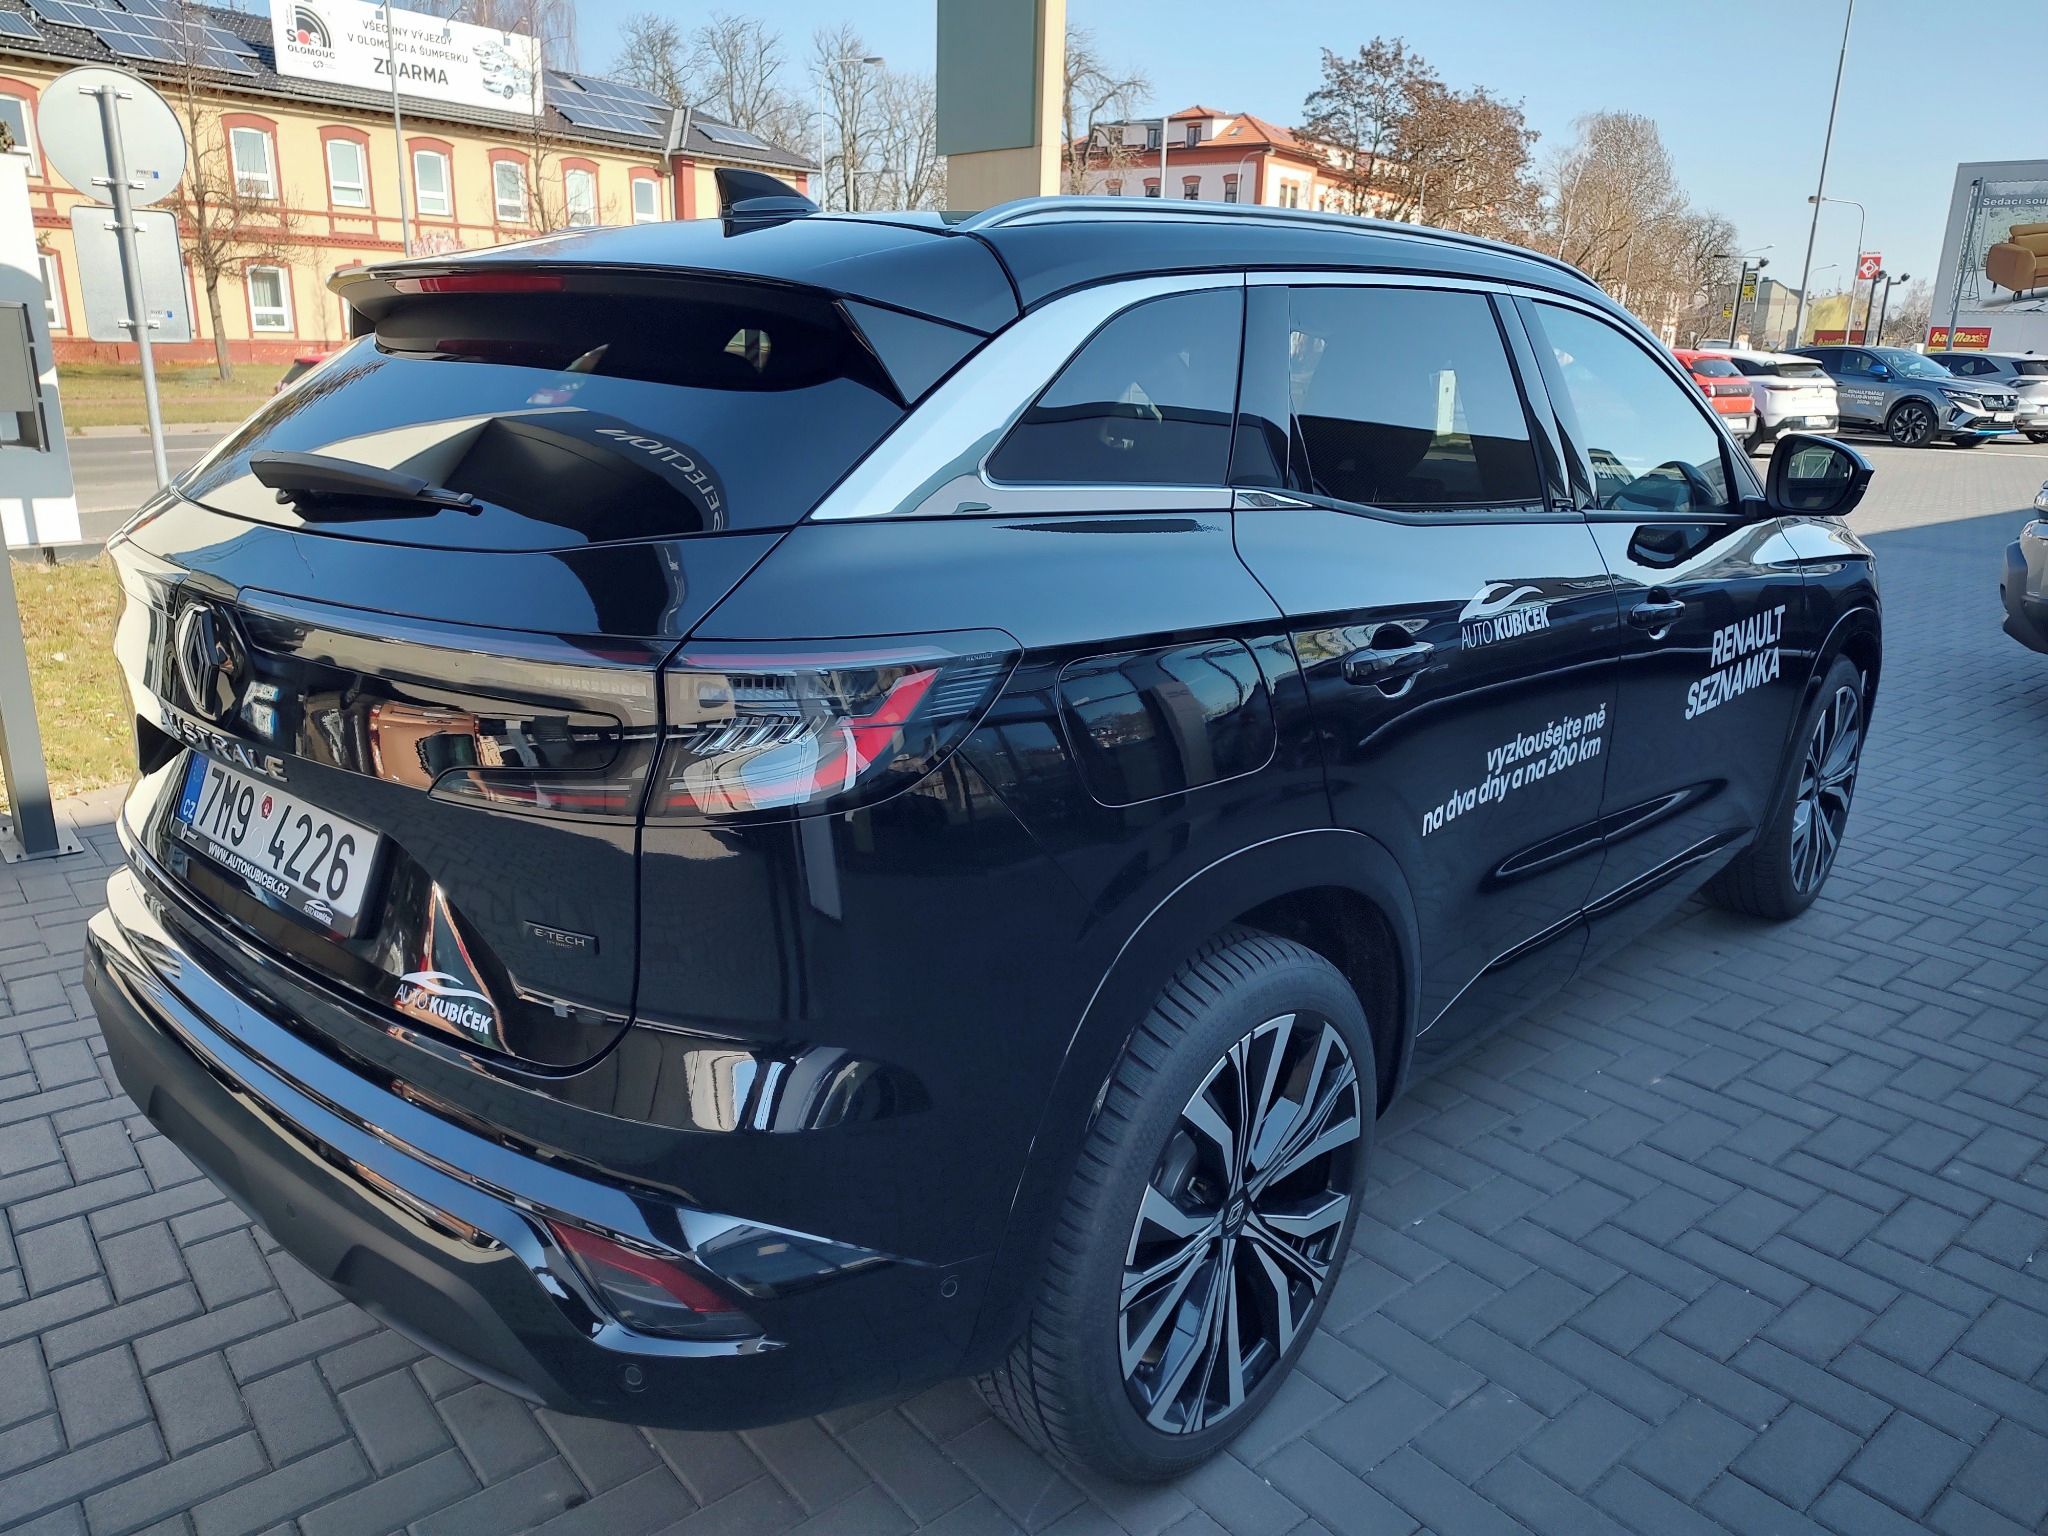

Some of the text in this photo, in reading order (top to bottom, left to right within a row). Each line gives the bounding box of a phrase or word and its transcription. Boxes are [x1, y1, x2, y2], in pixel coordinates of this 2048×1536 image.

[287, 44, 336, 60] OLOMOUC
[347, 32, 354, 42] V
[410, 45, 417, 55] A
[419, 45, 469, 64] ŠUMPERKU
[373, 57, 449, 85] ZDARMA
[1462, 605, 1550, 651] AUTO KUBÍČEK
[1710, 604, 1786, 669] RENAULT
[1685, 646, 1780, 720] SEZNAMKA
[160, 706, 289, 783] AUSTRALE
[1487, 702, 1607, 775] vyzkoušejte mě
[183, 798, 197, 820] CZ
[1422, 736, 1602, 837] na dva dny a na 200 km
[199, 767, 356, 901] 7M9 4226
[208, 841, 290, 899] WWW.AUTOKUBICEK.CZ
[534, 927, 586, 947] E-TECH
[395, 983, 493, 1035] AUTO KUBÍČEK
